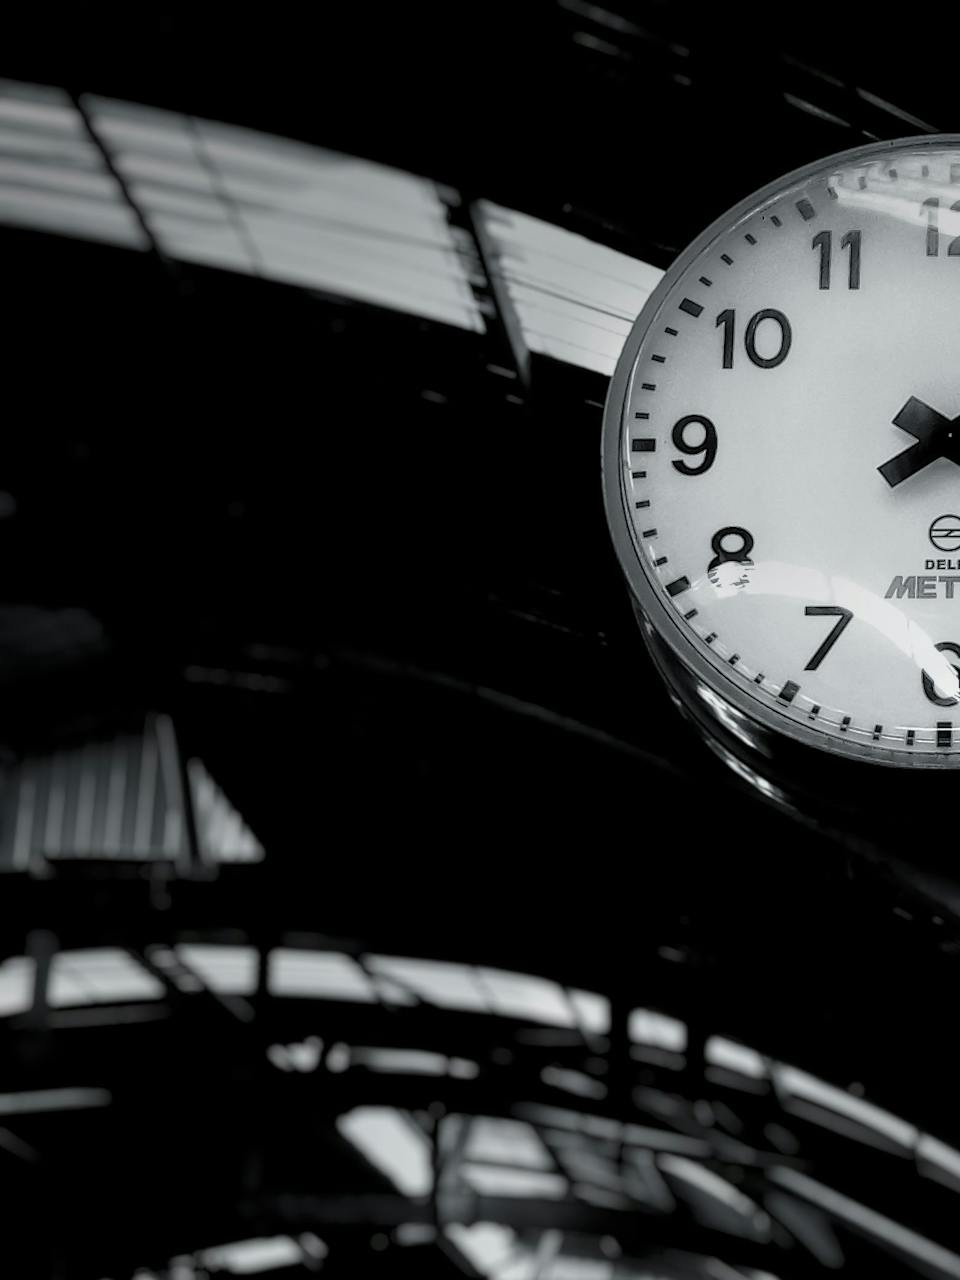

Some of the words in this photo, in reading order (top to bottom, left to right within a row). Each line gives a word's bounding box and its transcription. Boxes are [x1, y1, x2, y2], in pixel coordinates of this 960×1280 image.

[812, 230, 861, 290] 11
[715, 308, 792, 370] 10
[671, 414, 718, 476] 9
[804, 606, 854, 671] 7
